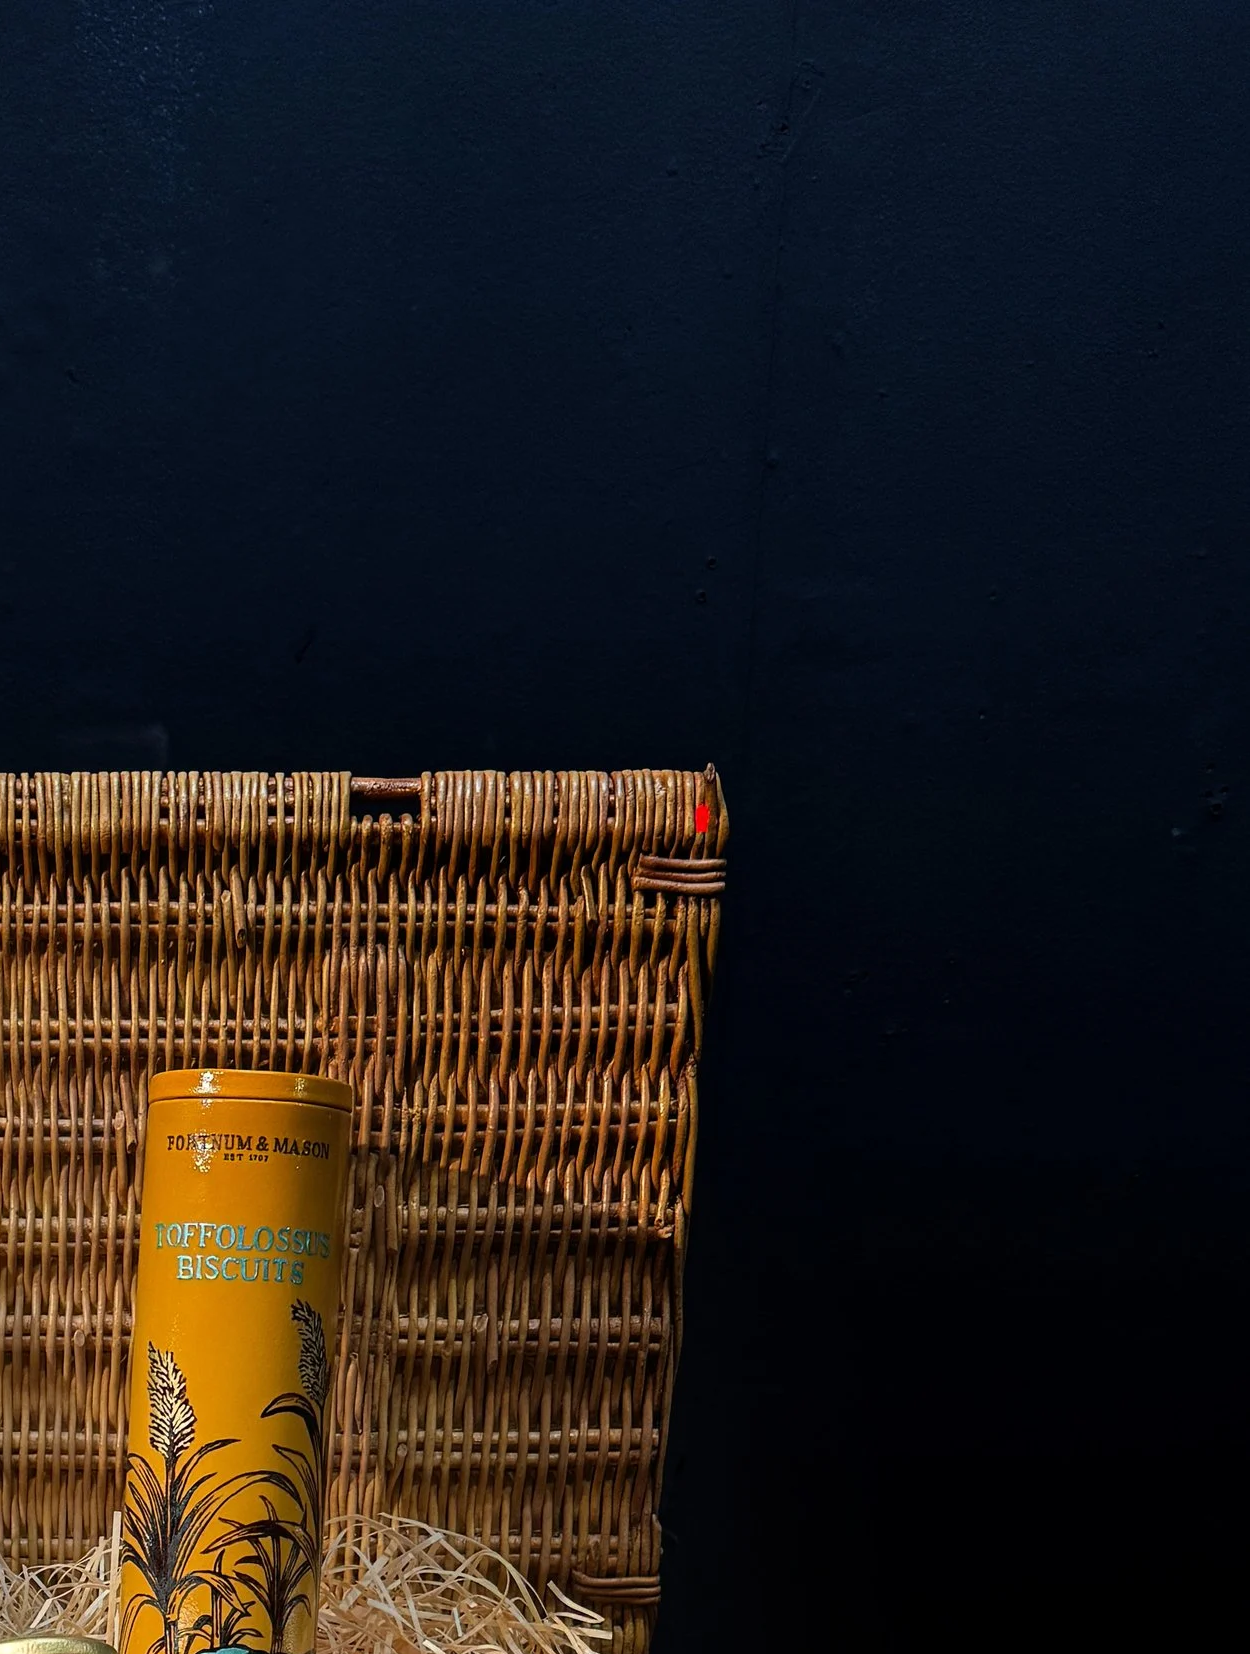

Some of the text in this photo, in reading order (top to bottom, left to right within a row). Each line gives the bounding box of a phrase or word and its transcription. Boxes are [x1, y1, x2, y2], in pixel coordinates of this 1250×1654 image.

[167, 1134, 329, 1159] FORTNUM & MASON
[223, 1153, 269, 1162] EST 1707
[155, 1222, 331, 1258] TOFFOLOSSUS
[176, 1255, 305, 1285] BISCUITS
